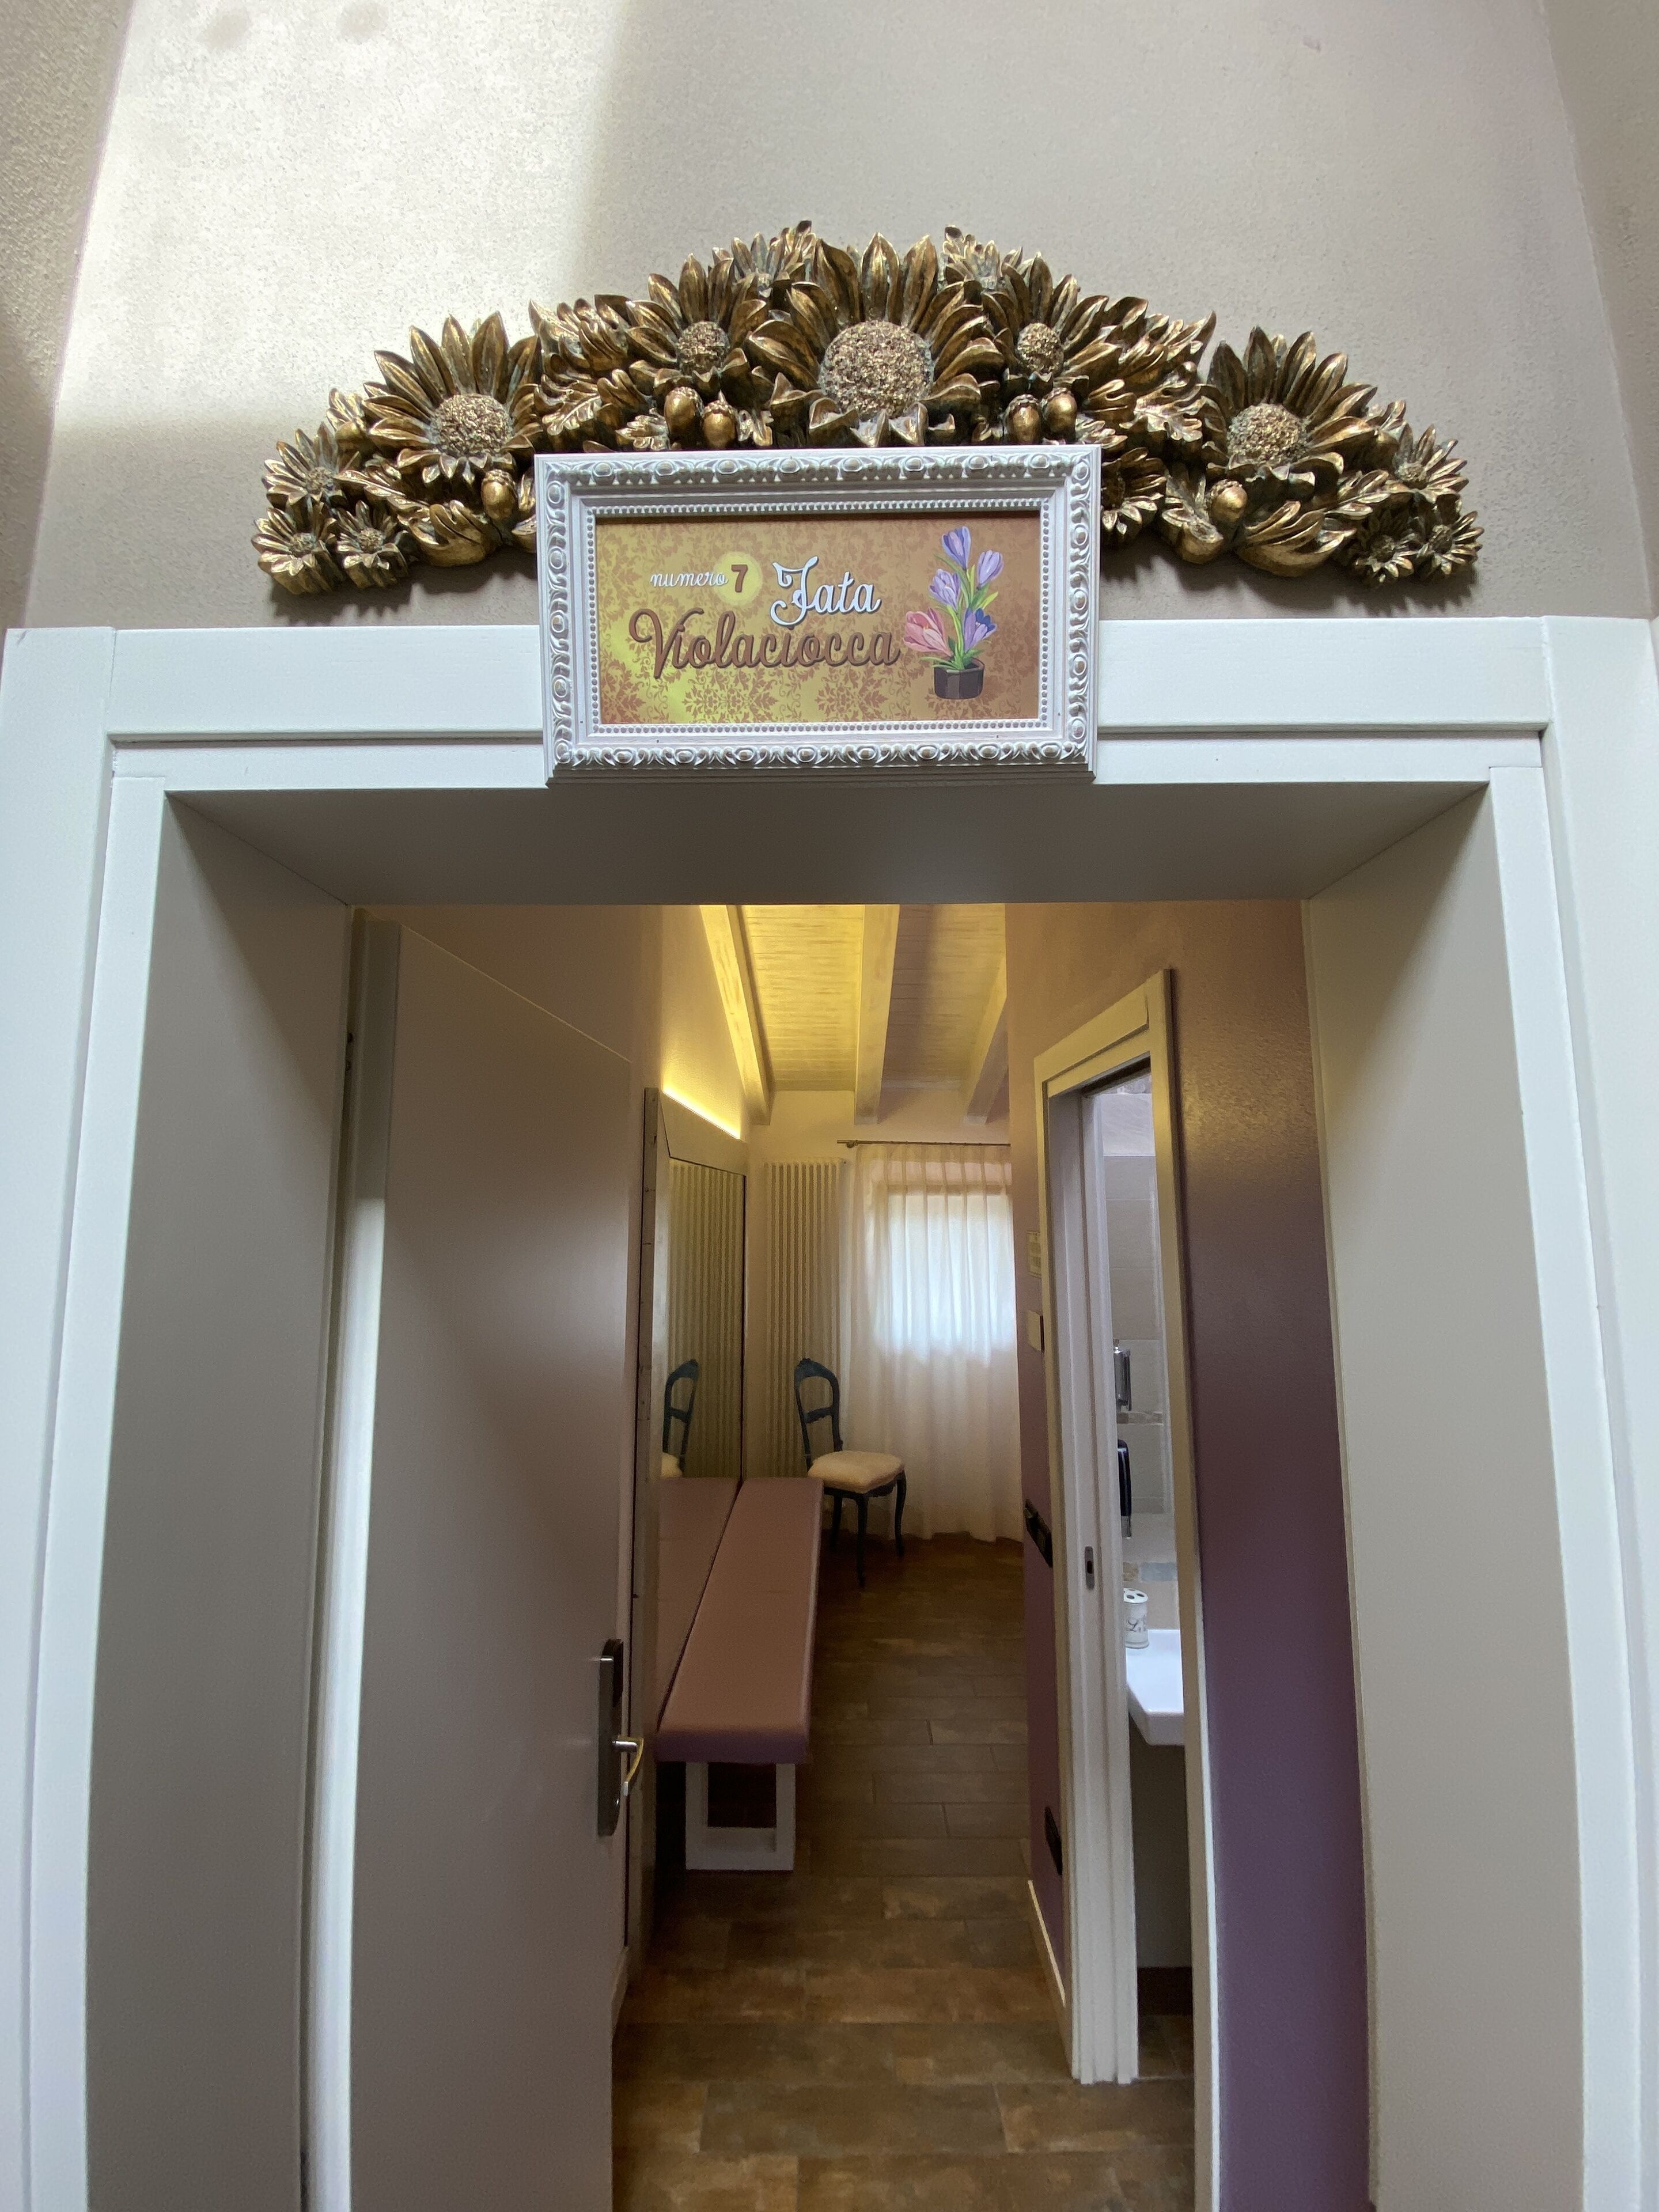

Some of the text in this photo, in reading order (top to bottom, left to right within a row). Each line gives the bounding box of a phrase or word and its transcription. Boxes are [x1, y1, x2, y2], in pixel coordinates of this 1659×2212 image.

[649, 564, 748, 593] numero 7
[770, 556, 882, 627] Fata
[628, 608, 900, 679] Violaciocca
